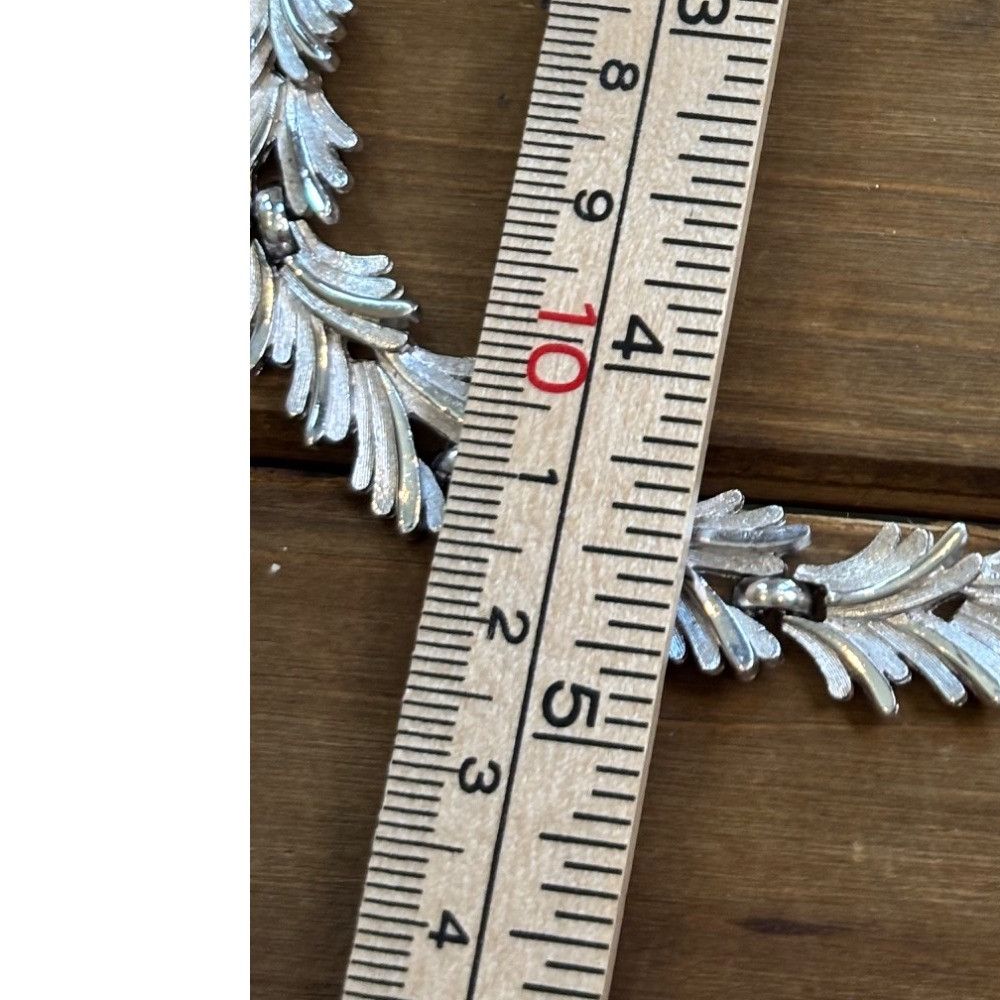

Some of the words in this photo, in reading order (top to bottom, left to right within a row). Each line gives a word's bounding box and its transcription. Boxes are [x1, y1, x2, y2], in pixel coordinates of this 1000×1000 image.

[599, 59, 640, 91] 8
[573, 189, 614, 222] 9
[526, 303, 597, 394] 10
[611, 314, 664, 360] 4
[518, 468, 559, 485] 1
[486, 606, 530, 644] 2
[542, 680, 600, 727] 5
[458, 757, 502, 794] 3
[428, 910, 469, 949] 4
